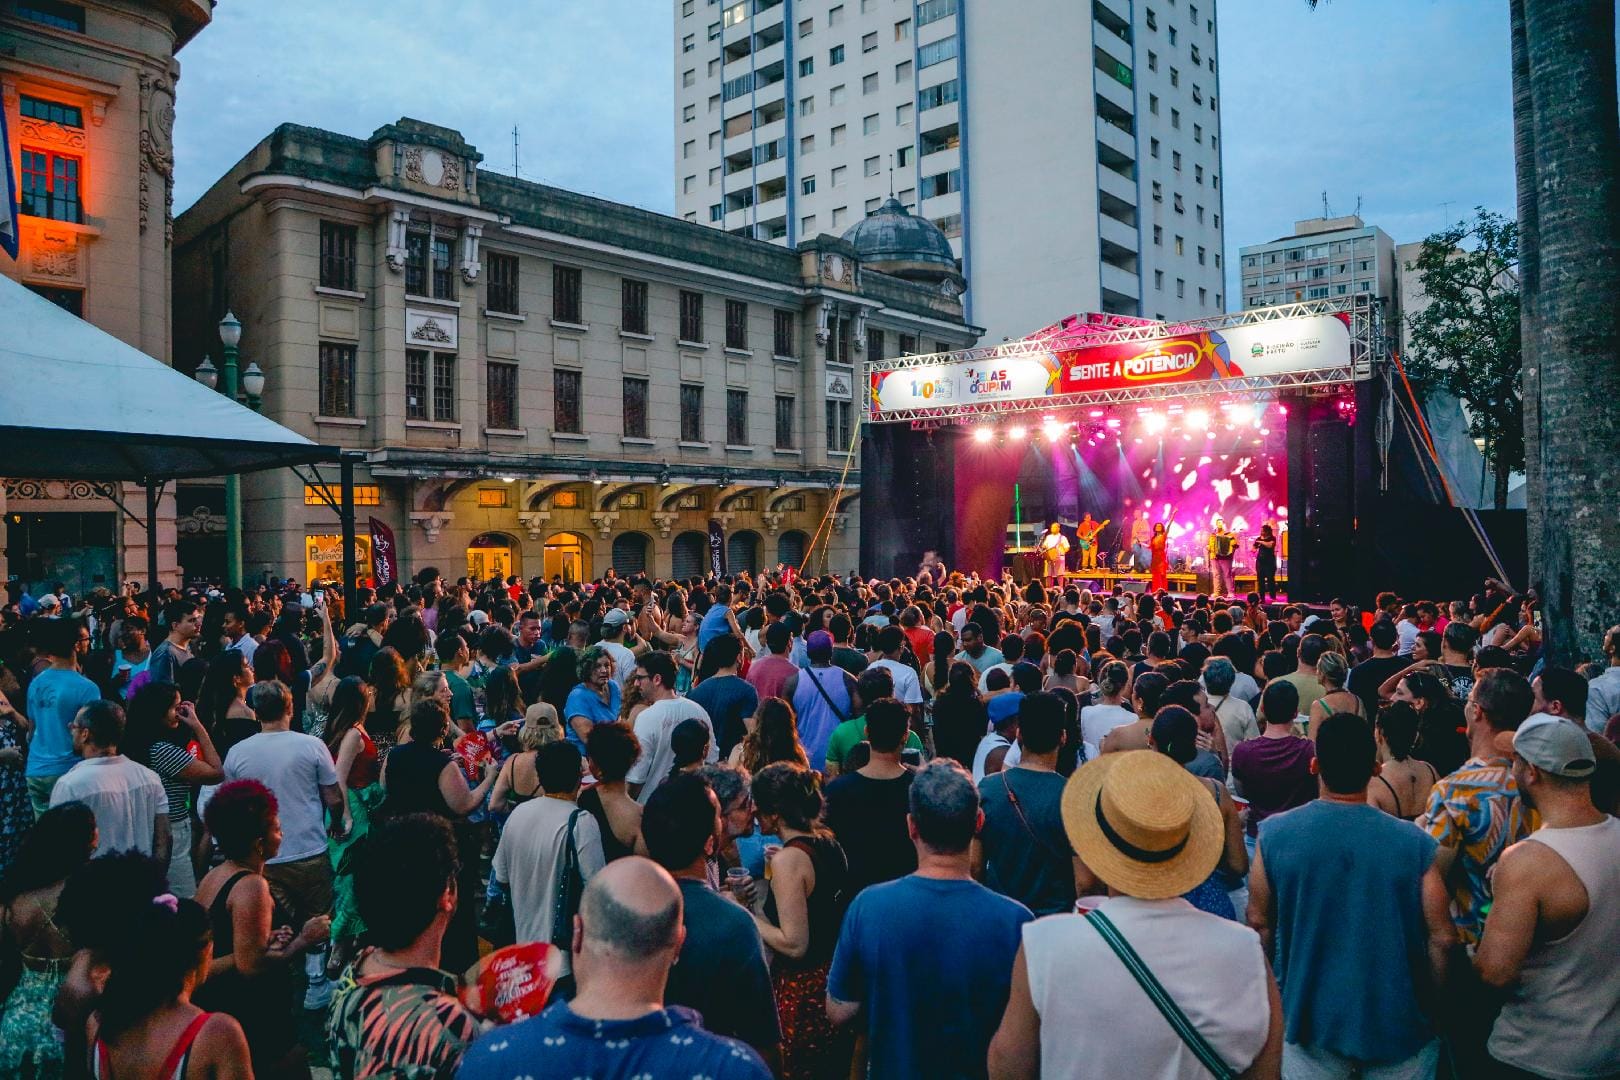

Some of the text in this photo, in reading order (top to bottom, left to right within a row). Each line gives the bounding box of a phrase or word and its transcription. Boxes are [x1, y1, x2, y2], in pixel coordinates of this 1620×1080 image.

[1069, 348, 1196, 381] SENTE A POTÊNCIA
[970, 380, 1012, 394] OCUPAM
